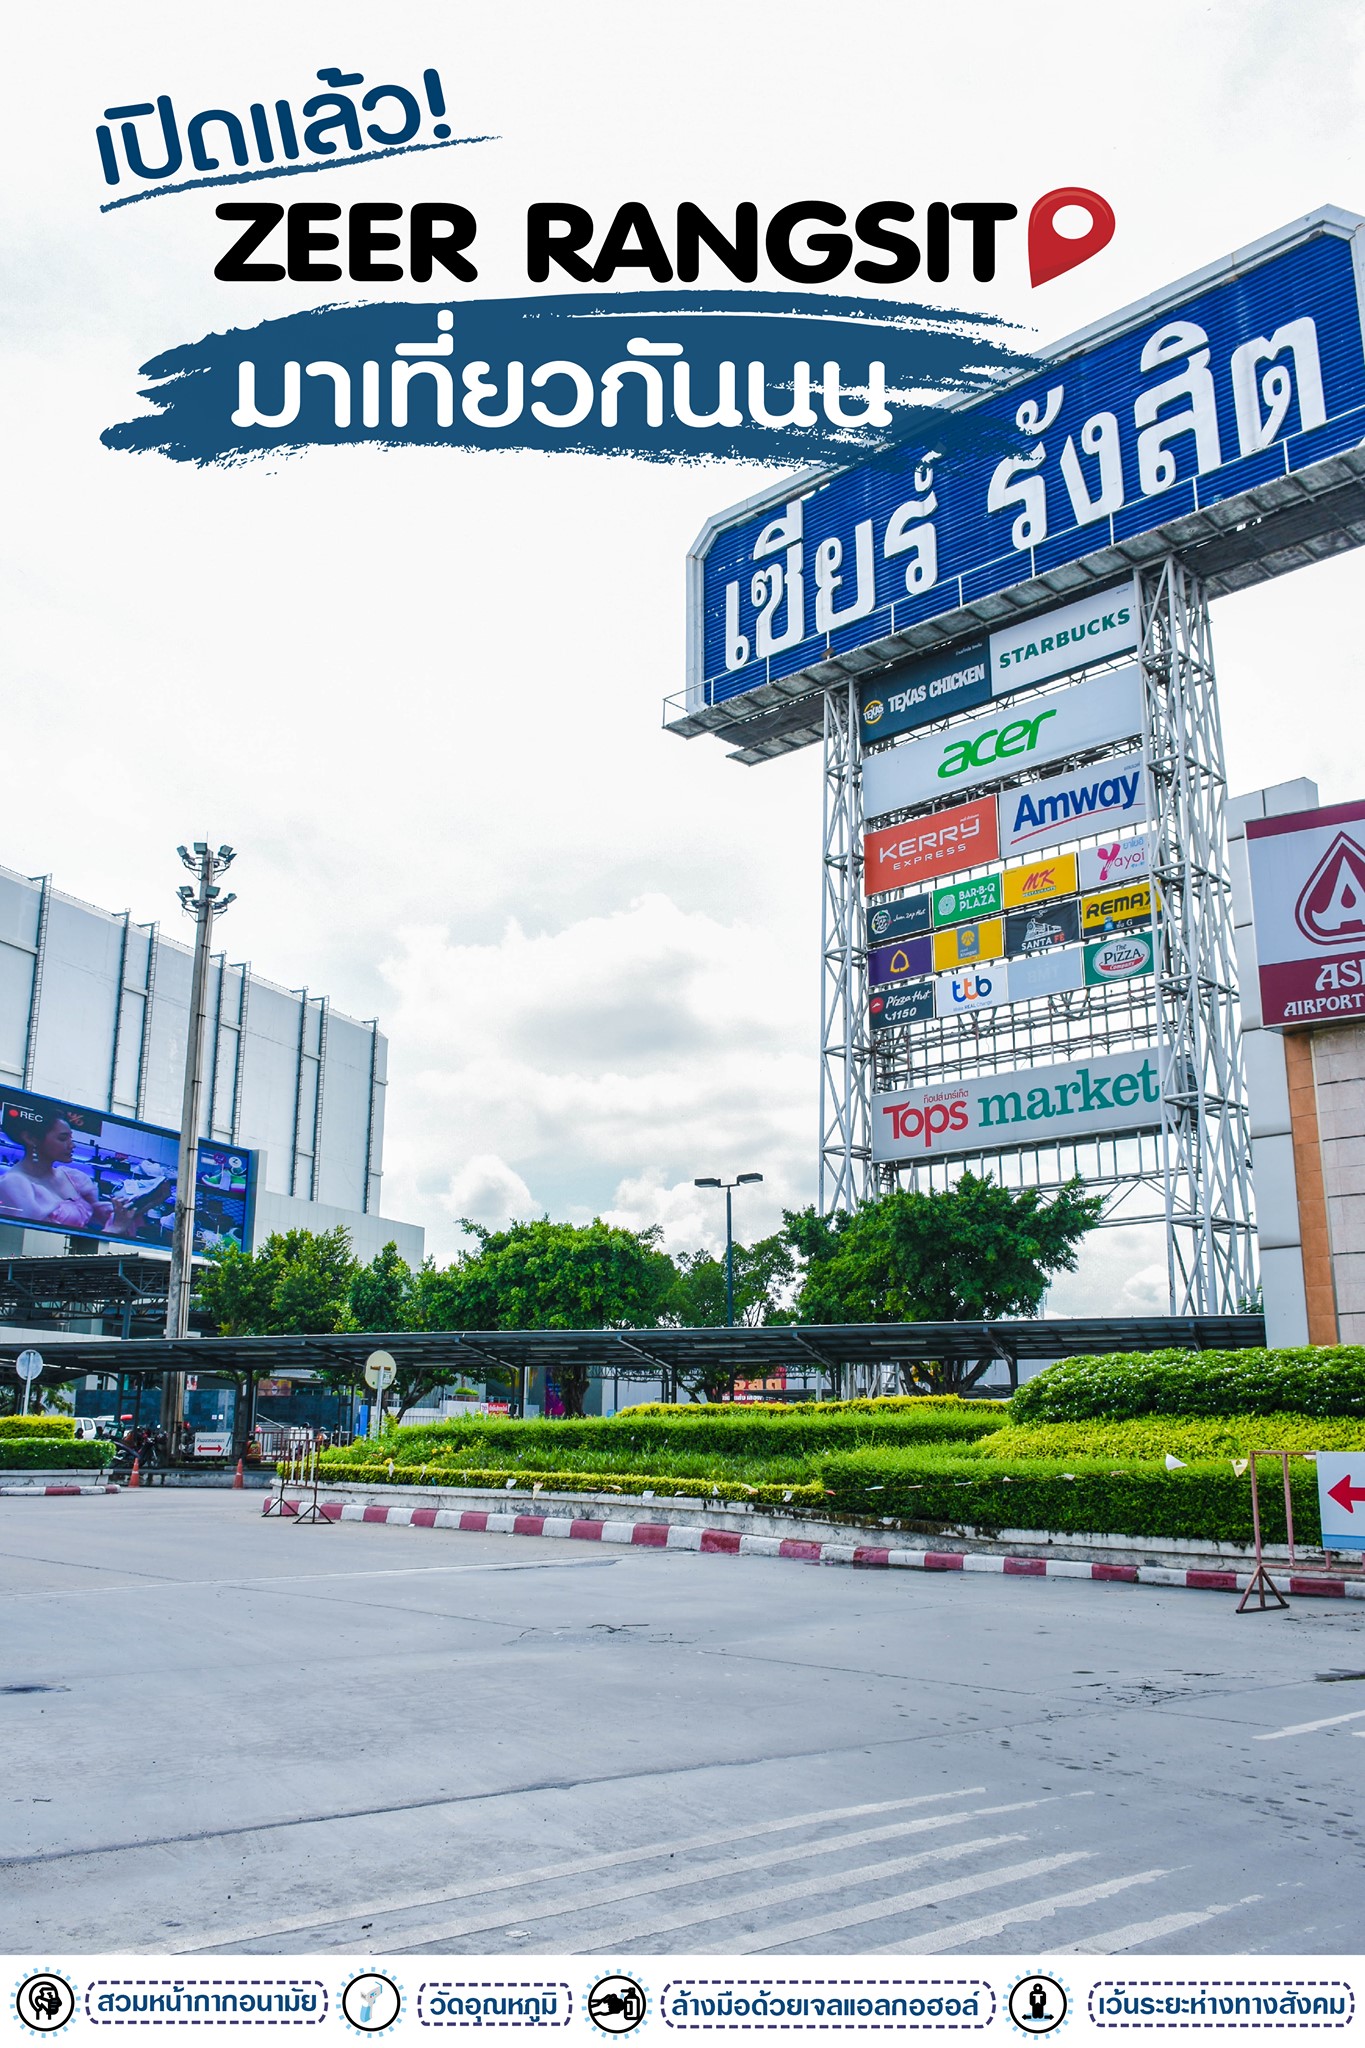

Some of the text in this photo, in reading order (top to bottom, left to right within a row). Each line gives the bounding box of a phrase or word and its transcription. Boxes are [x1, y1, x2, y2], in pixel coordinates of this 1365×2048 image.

[725, 316, 1327, 672] เซียร์ รังสิต
[999, 608, 1131, 669] STARBUCKS
[888, 663, 985, 713] TEXAS CHICKEN
[937, 709, 1057, 780] acer
[1013, 771, 1140, 833] Amway
[879, 818, 980, 864] KERRY
[893, 843, 967, 870] EXPRESS
[1022, 867, 1056, 891] MK
[959, 893, 996, 912] PLAZA
[1021, 937, 1052, 951] SANTA
[886, 995, 911, 1009] Pizza
[952, 975, 992, 1003] ttb
[891, 1007, 917, 1020] 1150
[1284, 993, 1365, 1017] AIRPORT
[20, 1110, 44, 1123] REC
[883, 1059, 1160, 1148] Tops market
